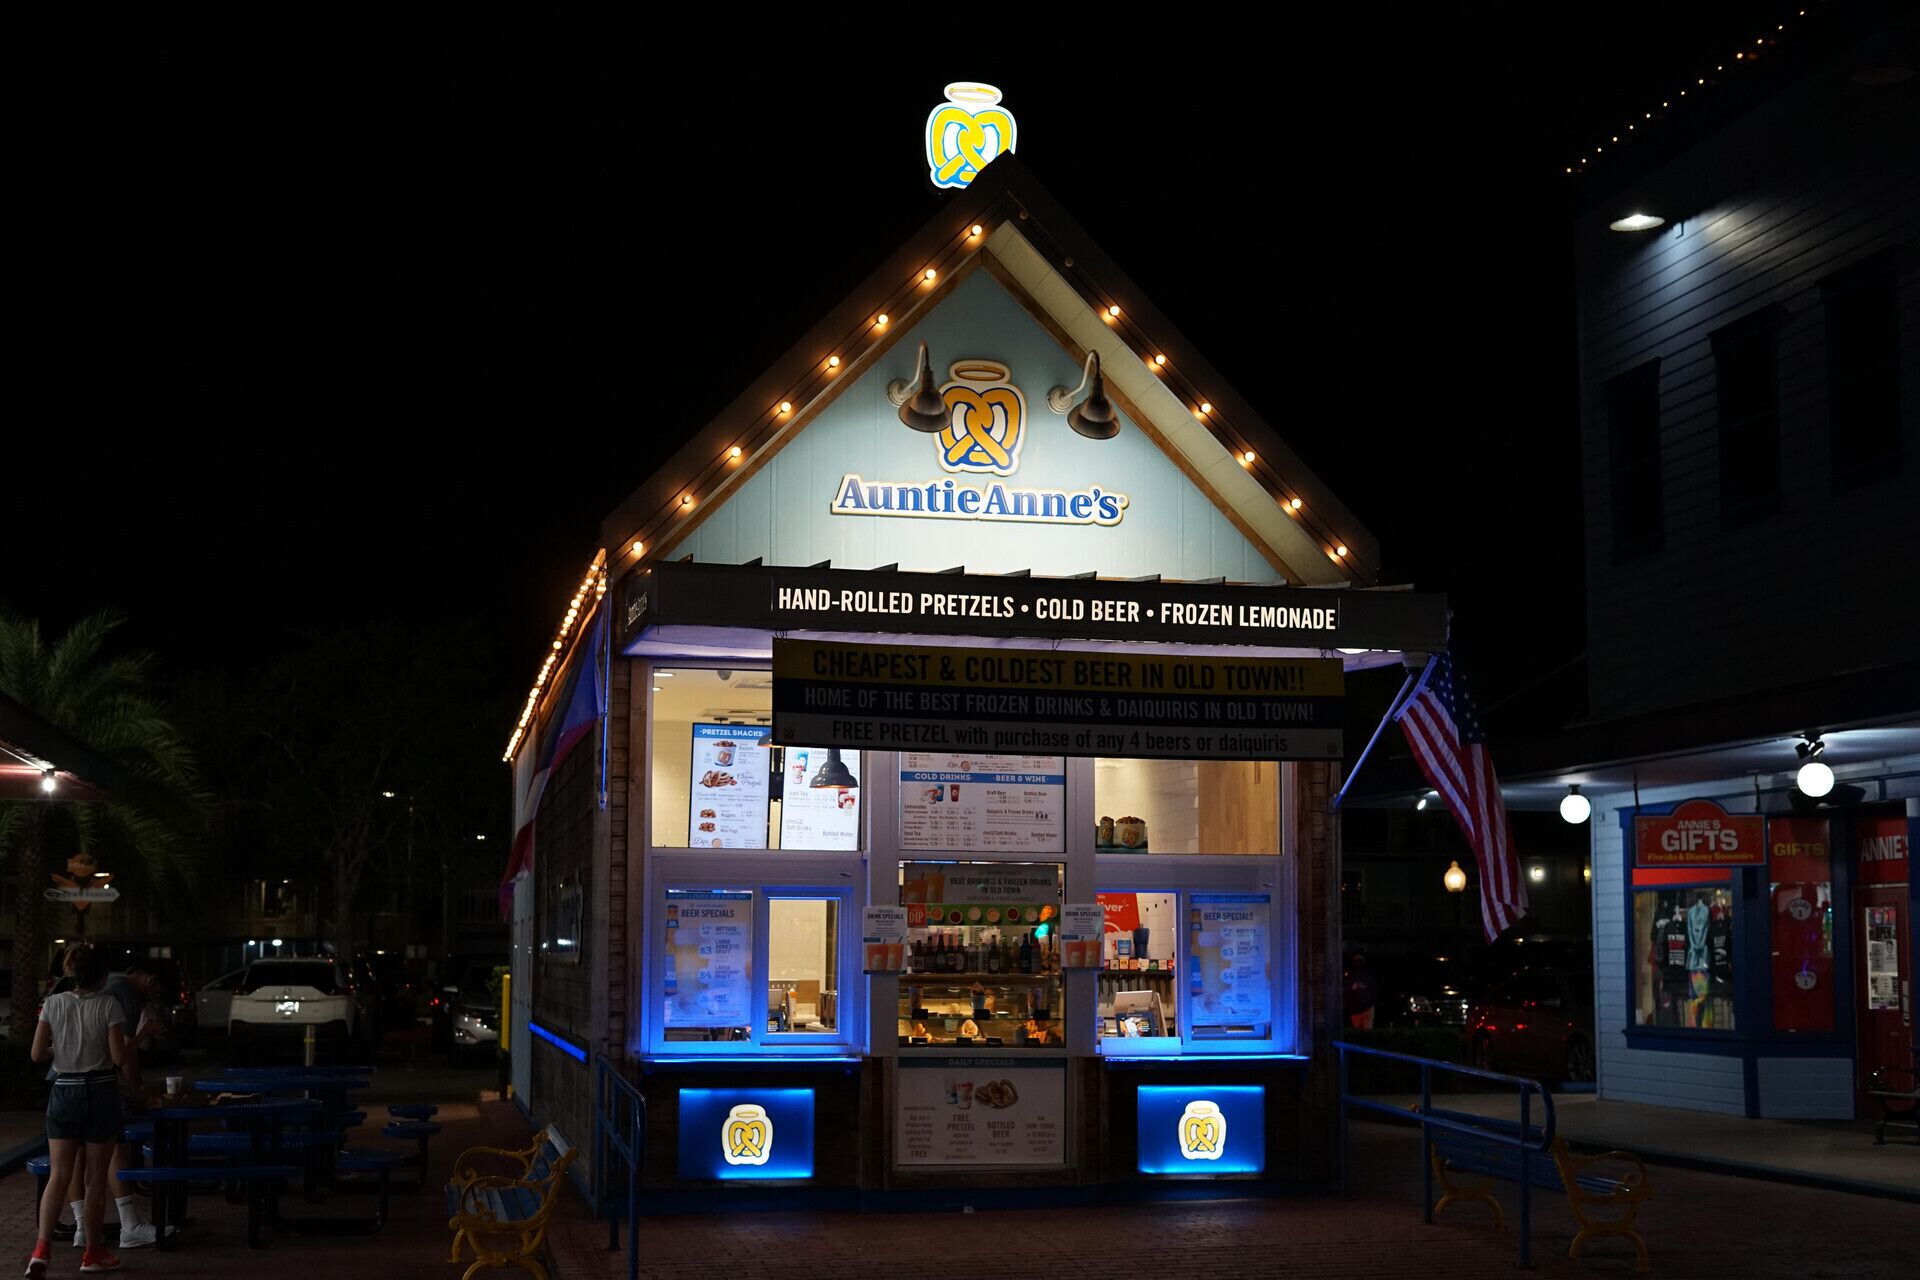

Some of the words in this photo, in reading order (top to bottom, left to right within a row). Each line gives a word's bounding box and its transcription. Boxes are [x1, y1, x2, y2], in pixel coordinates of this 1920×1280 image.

[838, 478, 980, 513] Auntie
[779, 588, 913, 614] HAND-ROLLED
[920, 594, 1015, 618] PRETZELS
[1036, 598, 1084, 620] COLD
[1092, 600, 1140, 623] BEER
[1161, 602, 1233, 627] FROZEN
[1239, 605, 1336, 630] LEMONADE
[813, 650, 930, 681] CHEAPEST
[940, 655, 955, 680] &
[965, 656, 1066, 685] COLDEST
[1074, 660, 1132, 688] BEER
[1142, 662, 1164, 689] IN
[1173, 664, 1214, 690] OLD
[1223, 665, 1305, 691] TOWN!!
[804, 686, 850, 707] HOME
[857, 689, 878, 709] OF
[883, 690, 915, 711] THE
[920, 692, 961, 712] BEST
[965, 693, 1029, 714] FROZEN
[1034, 696, 1094, 717] DRINKS
[1100, 699, 1112, 717] &
[1117, 699, 1199, 720] DAIQUIRIS
[1204, 702, 1221, 720] IN
[1226, 702, 1257, 721] OLD
[1261, 703, 1314, 721] TOWN!
[832, 720, 874, 741] FREE
[879, 722, 950, 744] PRETZEL
[955, 726, 988, 745] with
[995, 727, 1069, 750] purchase
[1076, 730, 1091, 747] of
[1097, 733, 1124, 752] any
[1130, 731, 1141, 749] 4
[1147, 732, 1191, 751] beers
[1197, 736, 1213, 751] or
[1219, 733, 1288, 755] daiquiris
[940, 773, 971, 781] DRINKS
[1678, 820, 1720, 830] ANNIE'S
[1661, 829, 1739, 852] GIFTS
[1773, 843, 1825, 856] GIFTS
[682, 909, 699, 917] BEER
[701, 909, 734, 918] SPECIALS
[909, 910, 924, 923] DIP
[1204, 912, 1220, 920] BEER
[1223, 912, 1255, 920] SPECIALS
